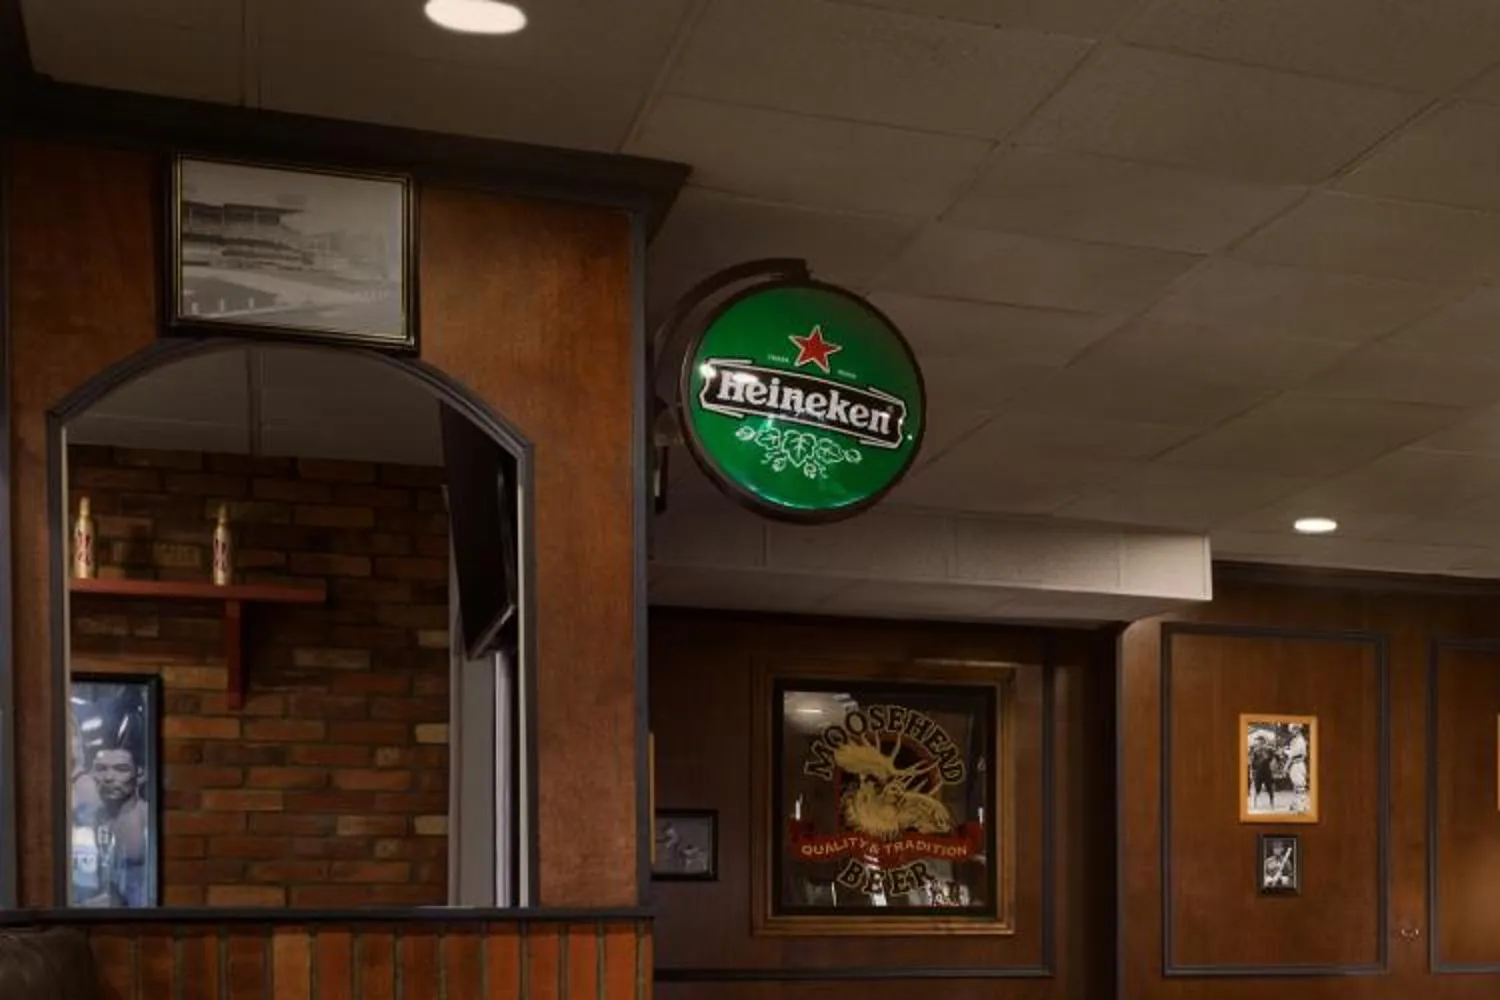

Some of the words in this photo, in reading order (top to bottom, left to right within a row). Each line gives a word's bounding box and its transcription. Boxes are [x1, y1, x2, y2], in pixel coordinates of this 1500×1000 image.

[716, 369, 892, 435] Heineken
[804, 705, 967, 785] MOOSEHEAD
[801, 836, 868, 855] QUALITY
[884, 839, 967, 857] TRADITION
[839, 859, 936, 896] BEER
